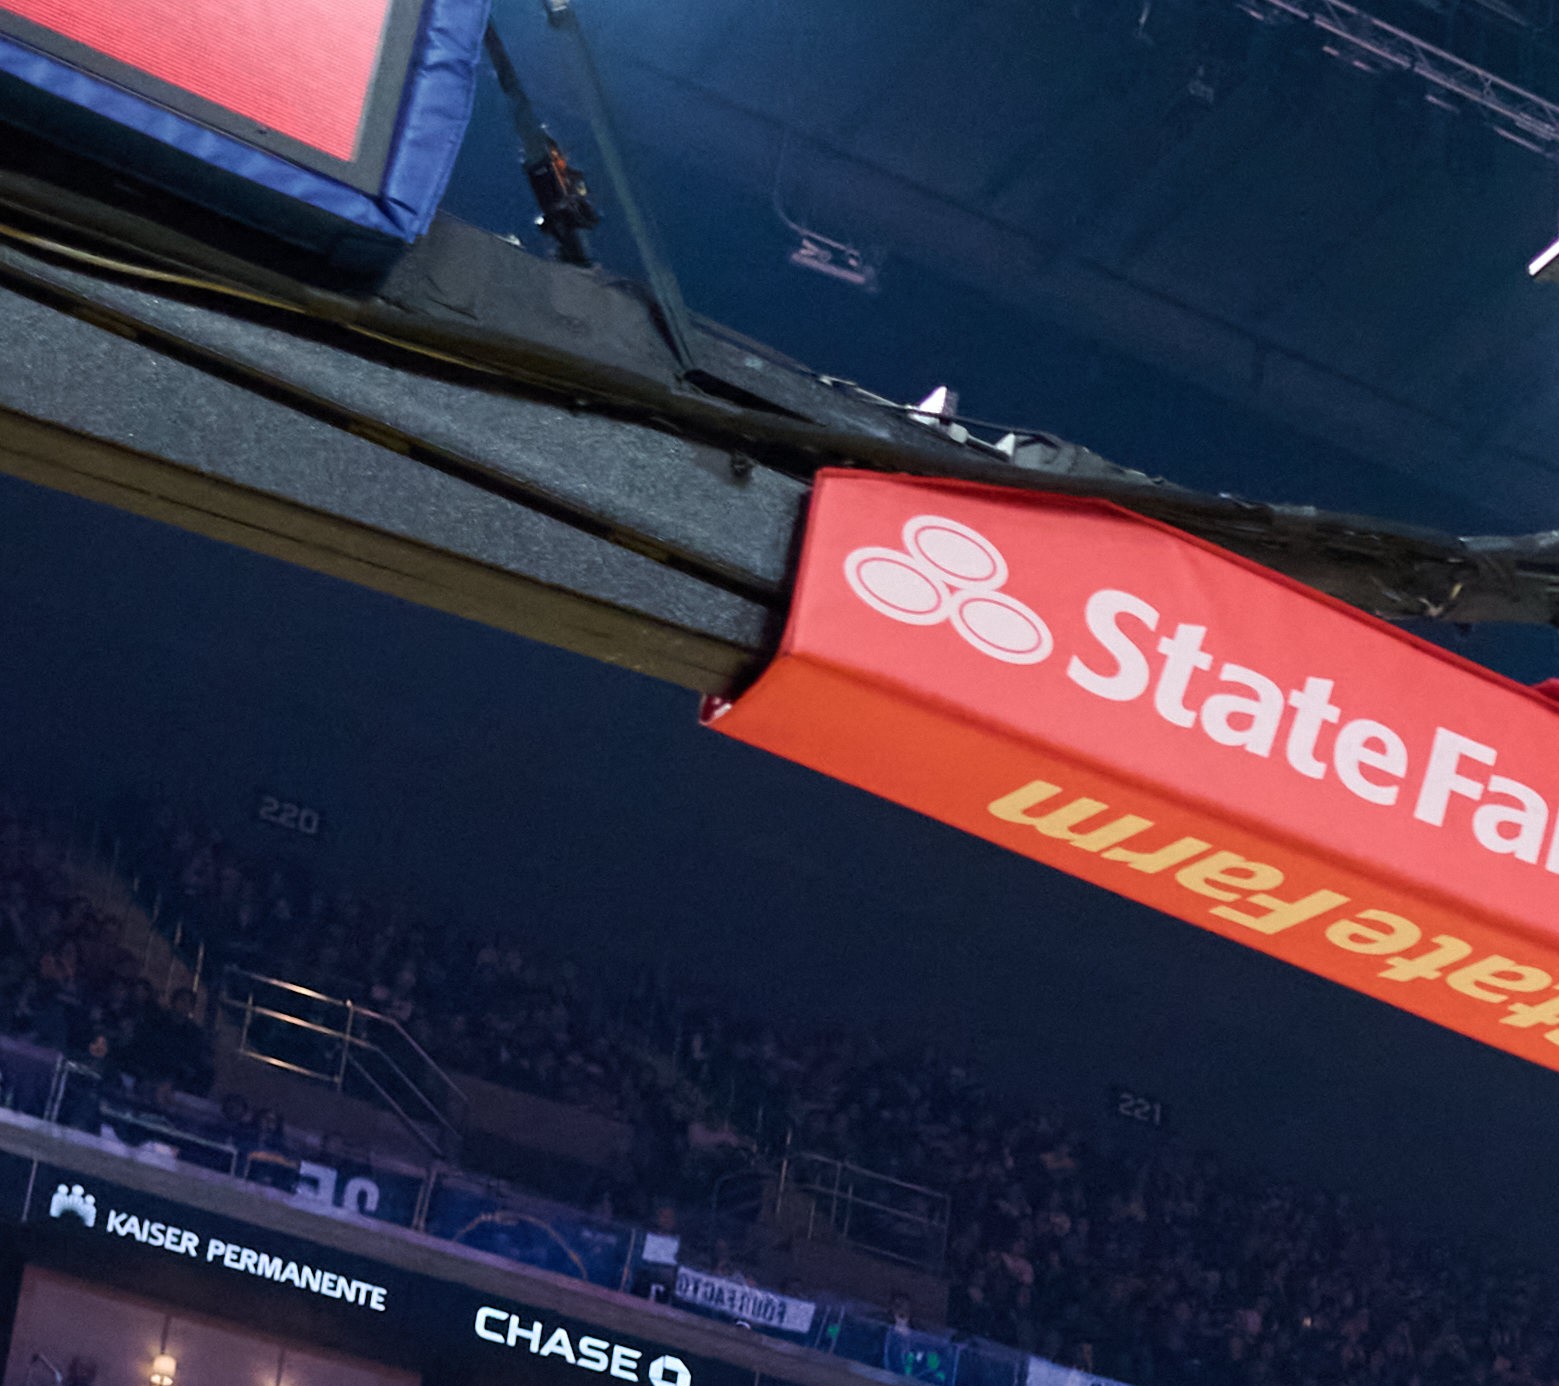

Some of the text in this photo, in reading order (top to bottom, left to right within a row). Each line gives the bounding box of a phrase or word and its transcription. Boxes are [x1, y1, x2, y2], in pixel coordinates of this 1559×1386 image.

[107, 1210, 388, 1312] KAISER PERMANENTE
[474, 1306, 643, 1383] CHASE
